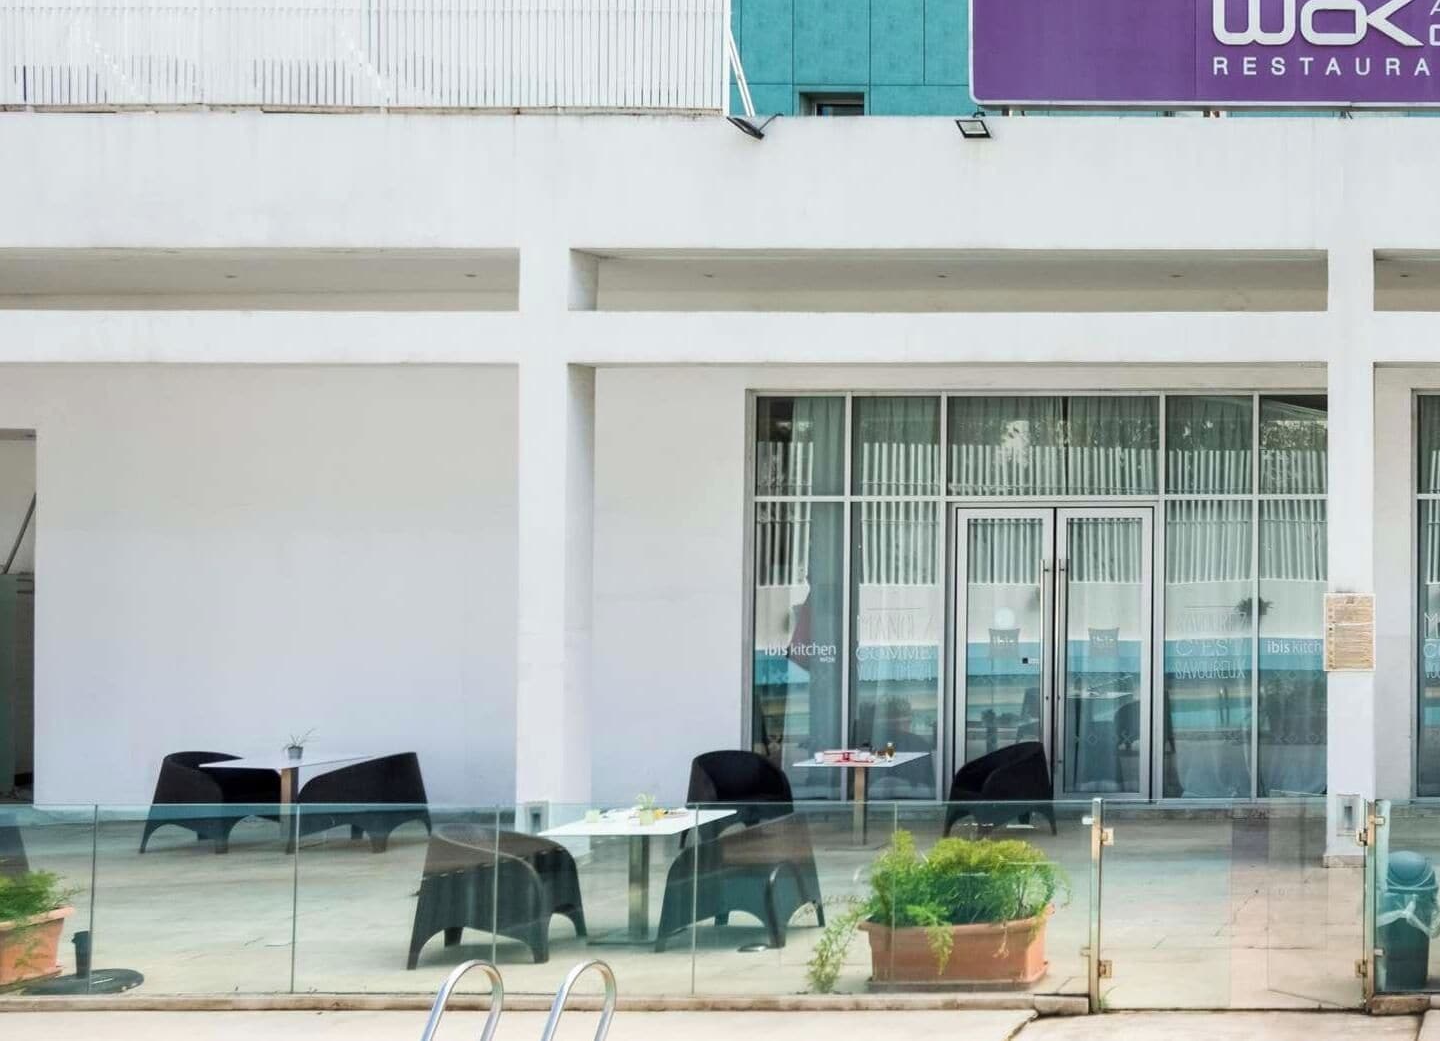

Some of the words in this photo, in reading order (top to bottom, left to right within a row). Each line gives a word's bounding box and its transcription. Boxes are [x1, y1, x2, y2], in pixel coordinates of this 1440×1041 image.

[790, 642, 836, 656] kitchen
[1267, 640, 1290, 654] ibis
[1292, 640, 1322, 654] kitch
